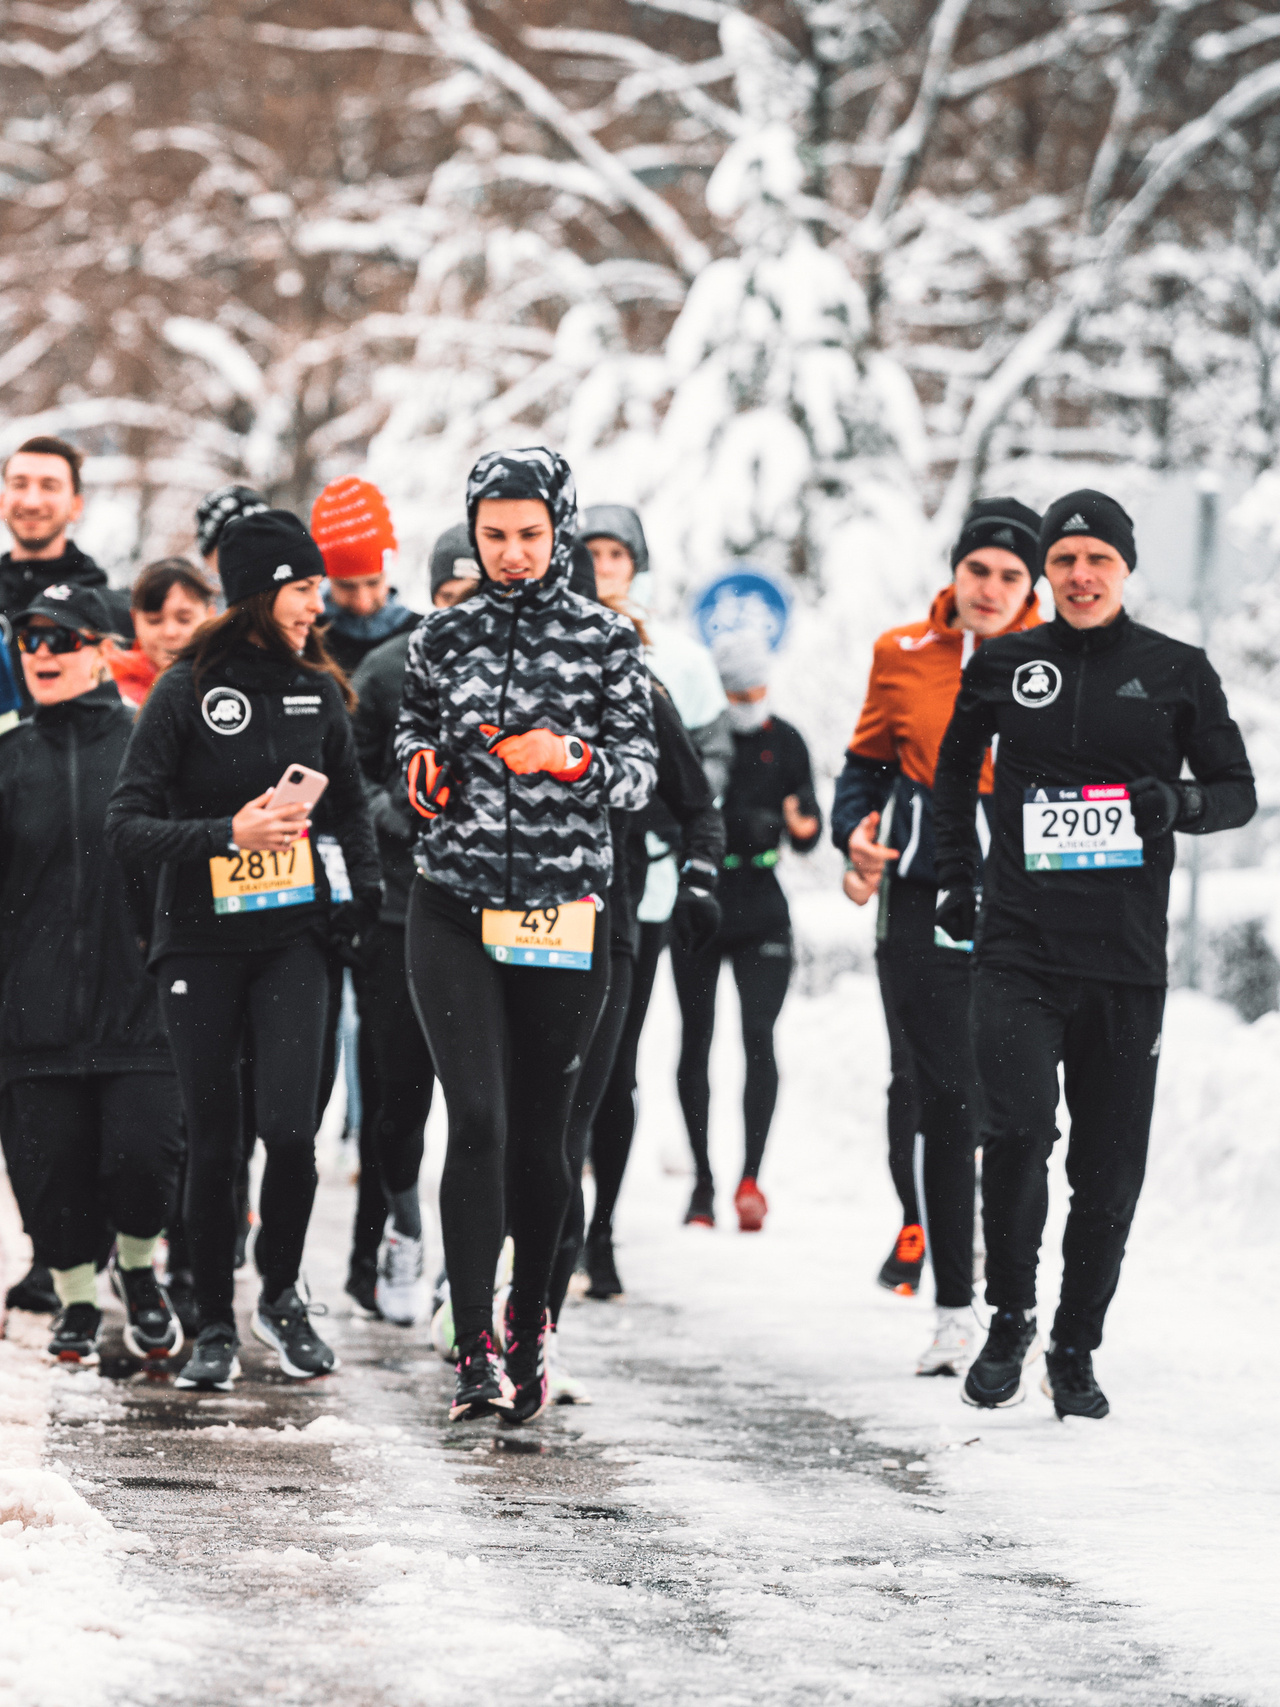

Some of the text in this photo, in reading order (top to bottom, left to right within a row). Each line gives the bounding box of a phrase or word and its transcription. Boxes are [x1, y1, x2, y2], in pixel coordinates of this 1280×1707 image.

[1041, 807, 1123, 838] 2909
[228, 847, 296, 882] 2817
[227, 896, 241, 912] D
[520, 906, 559, 934] 49
